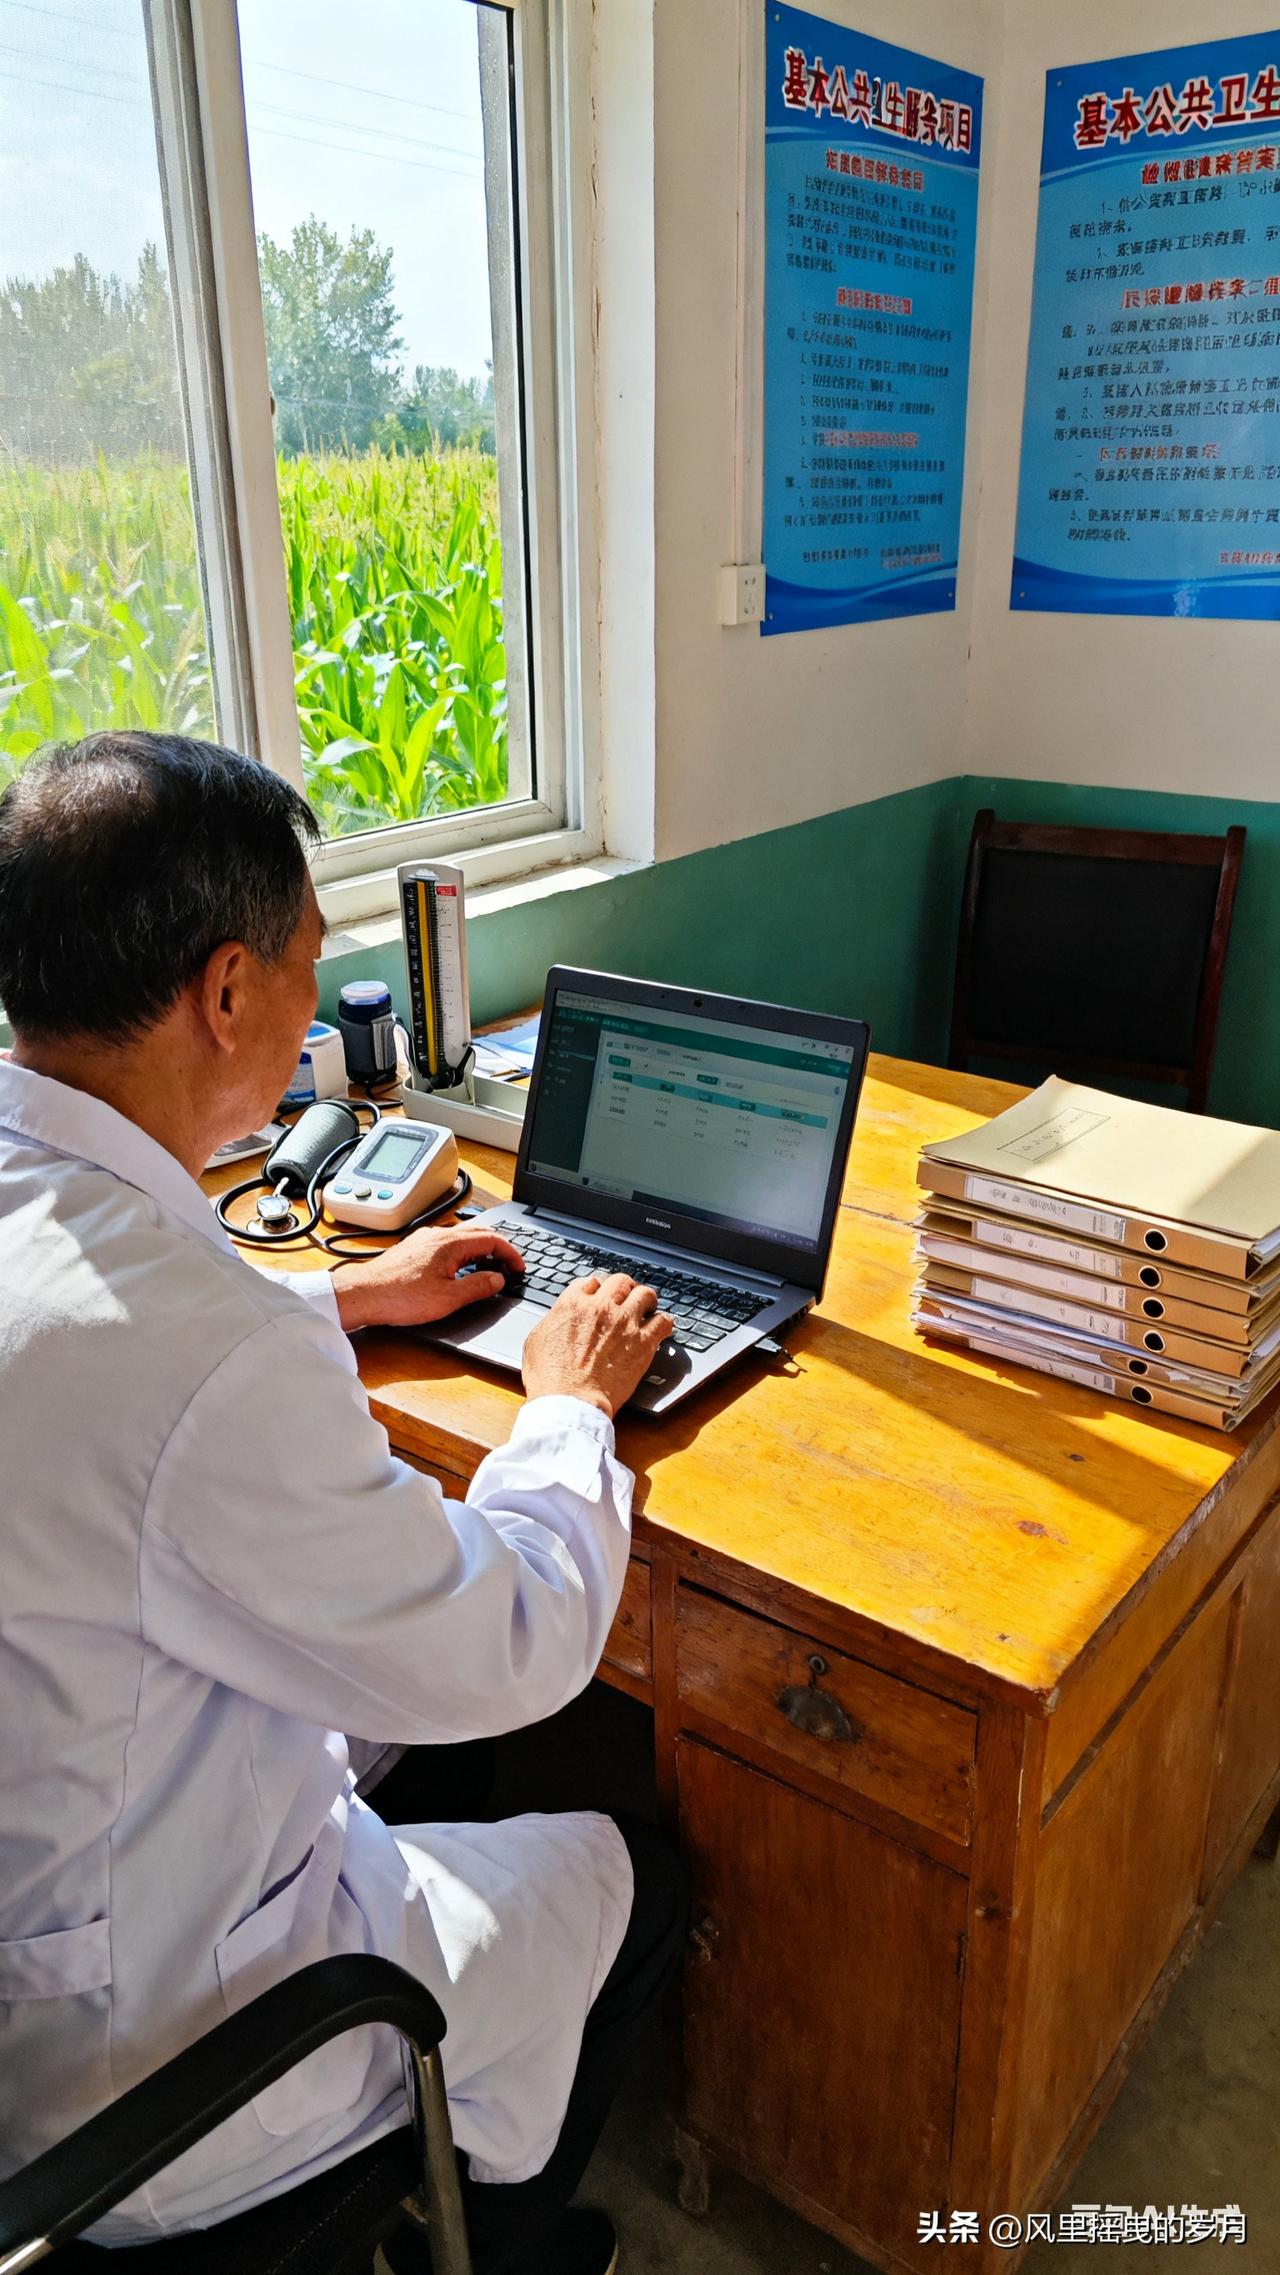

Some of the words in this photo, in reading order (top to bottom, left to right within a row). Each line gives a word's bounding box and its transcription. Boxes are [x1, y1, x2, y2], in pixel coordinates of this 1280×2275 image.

[1074, 64, 1280, 150] 基本公共卫生
